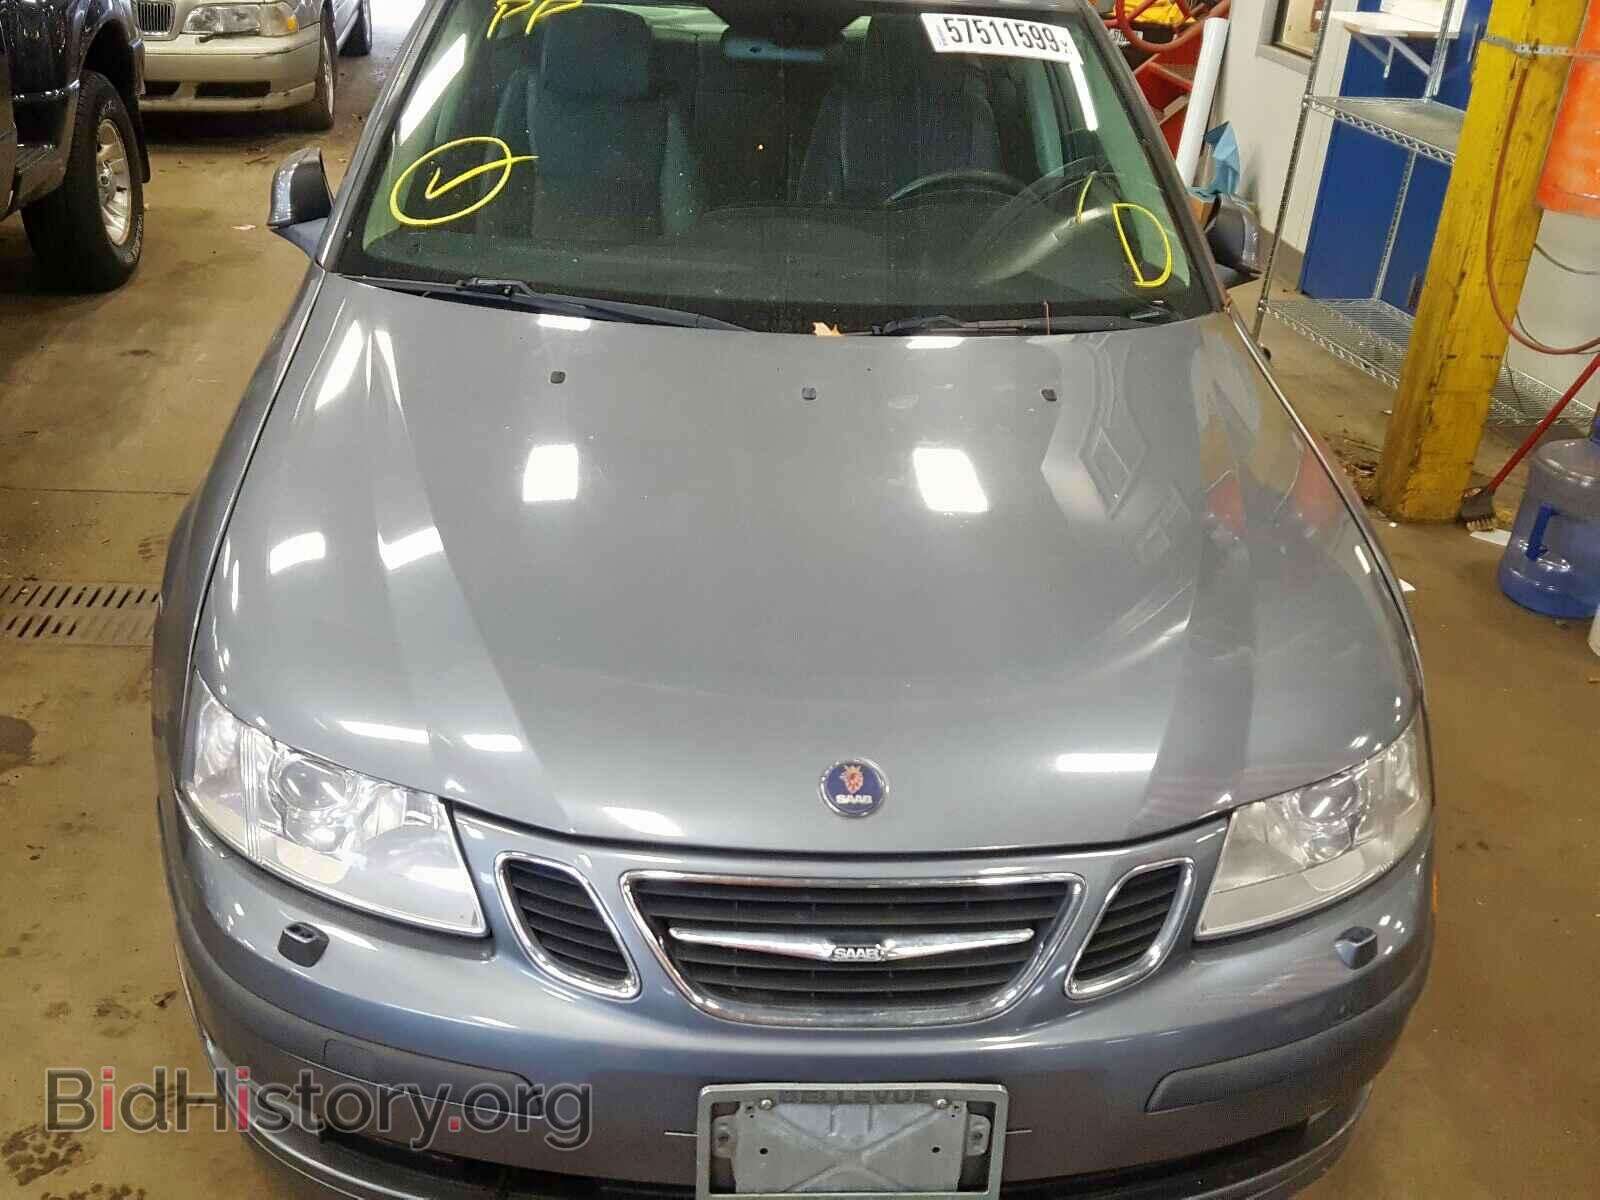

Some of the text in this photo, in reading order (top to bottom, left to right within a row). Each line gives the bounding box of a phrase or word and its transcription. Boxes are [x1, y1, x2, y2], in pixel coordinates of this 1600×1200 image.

[943, 17, 1060, 52] 57511599
[835, 794, 873, 805] SAAB
[834, 947, 880, 961] SAAB
